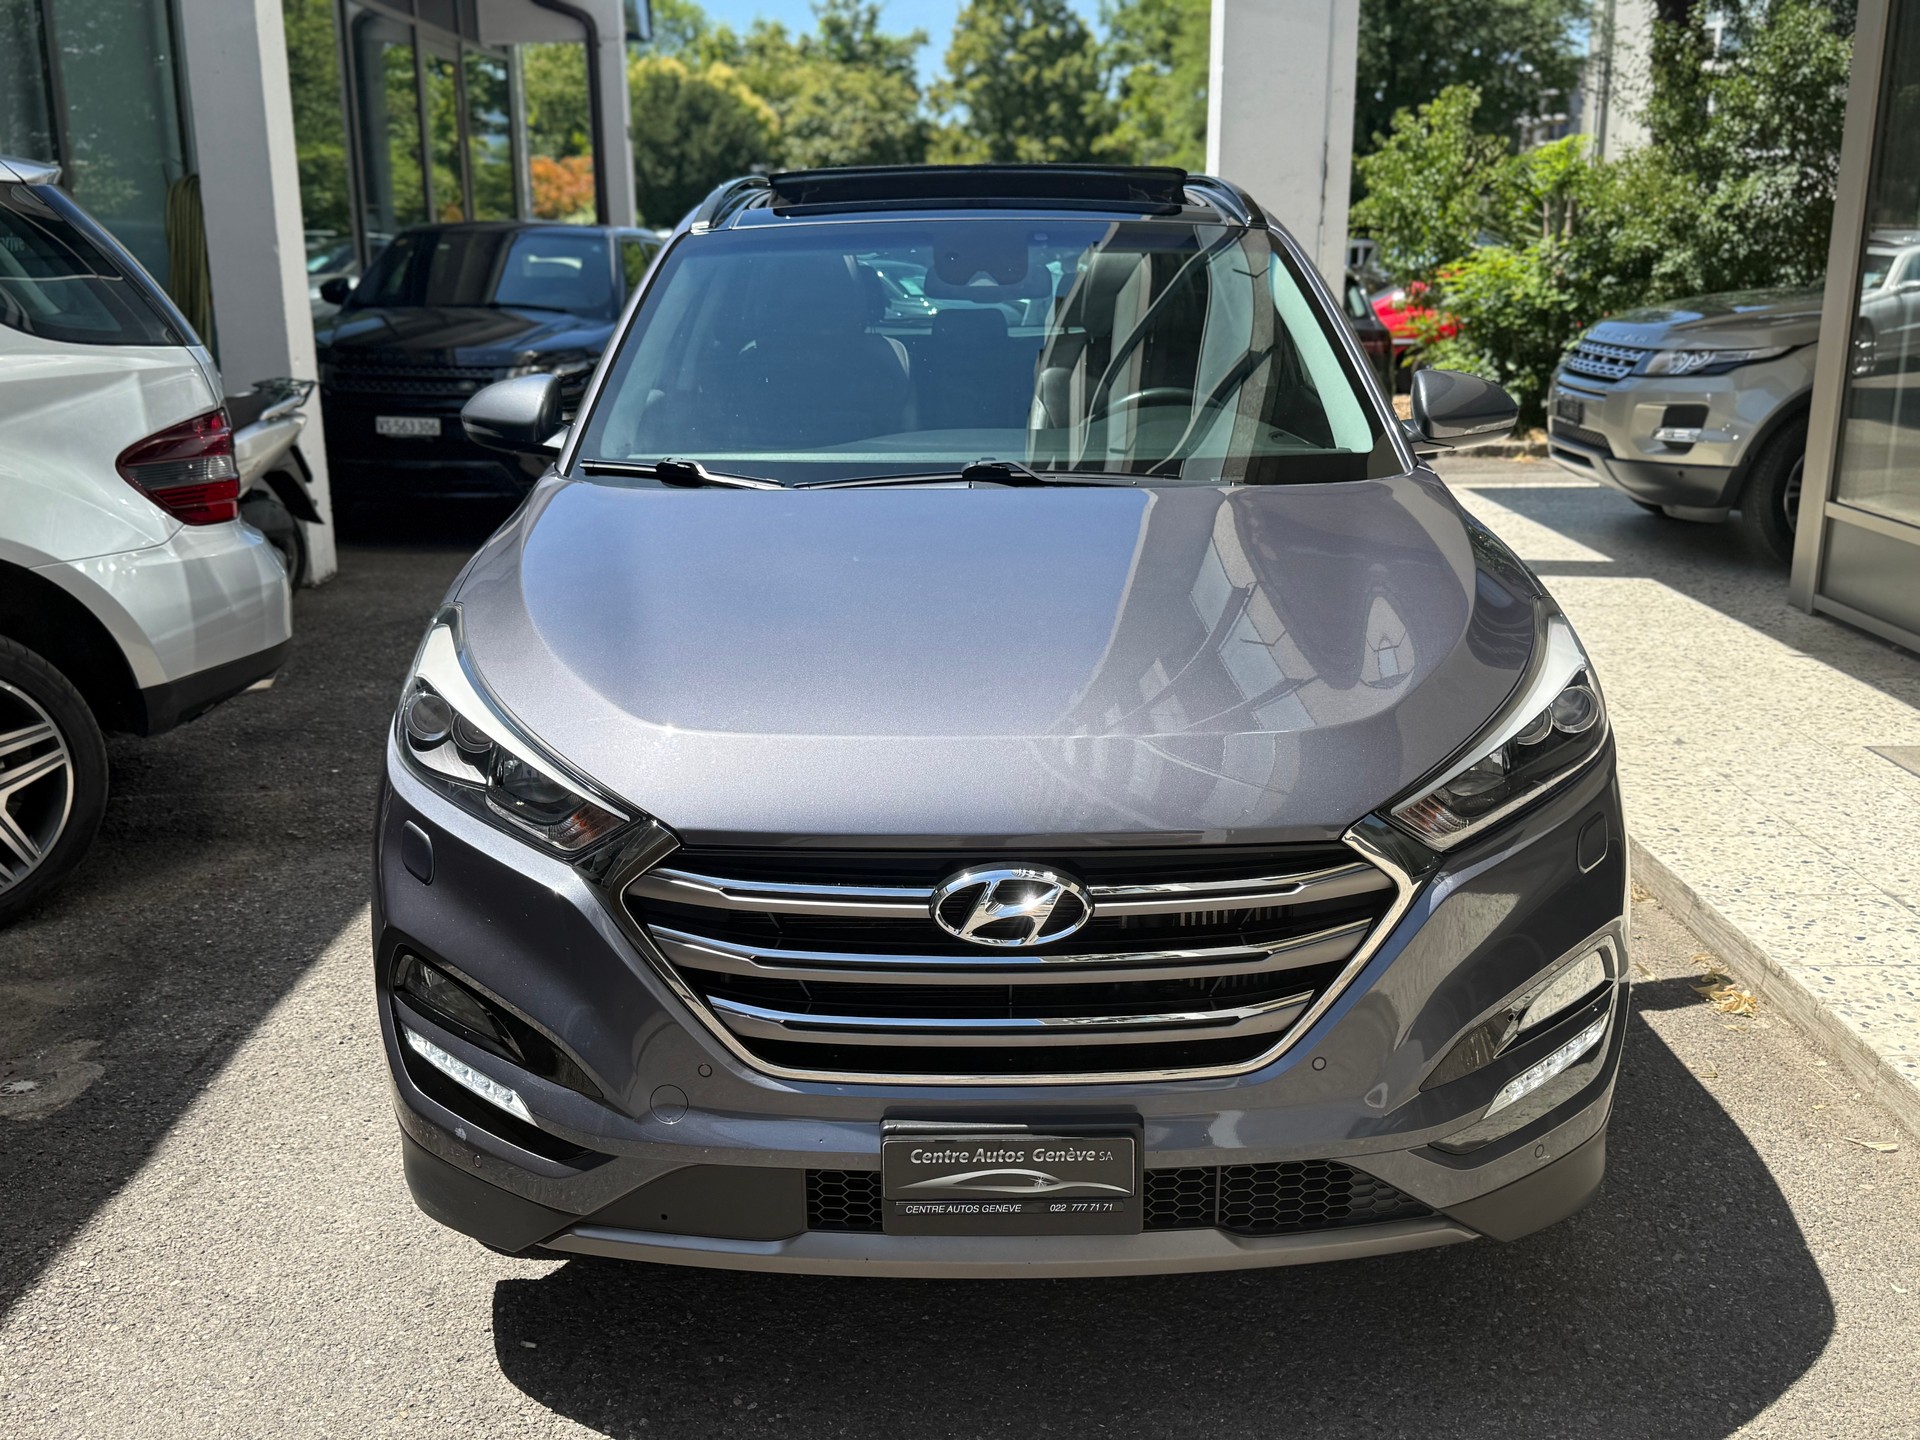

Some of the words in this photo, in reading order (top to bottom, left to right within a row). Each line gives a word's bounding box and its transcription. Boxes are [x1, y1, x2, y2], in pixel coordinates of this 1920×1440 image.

[910, 1148, 970, 1164] Centre
[972, 1148, 1025, 1163] Autos
[1032, 1147, 1096, 1162] Genève
[1099, 1151, 1114, 1161] SA
[905, 1205, 945, 1214] CENTRE
[946, 1204, 979, 1213] AUTOS
[981, 1204, 1022, 1213] GENEVE
[1049, 1203, 1067, 1212] 022
[1071, 1203, 1088, 1212] 777
[1089, 1203, 1100, 1212] 71
[1103, 1203, 1113, 1212] 71
